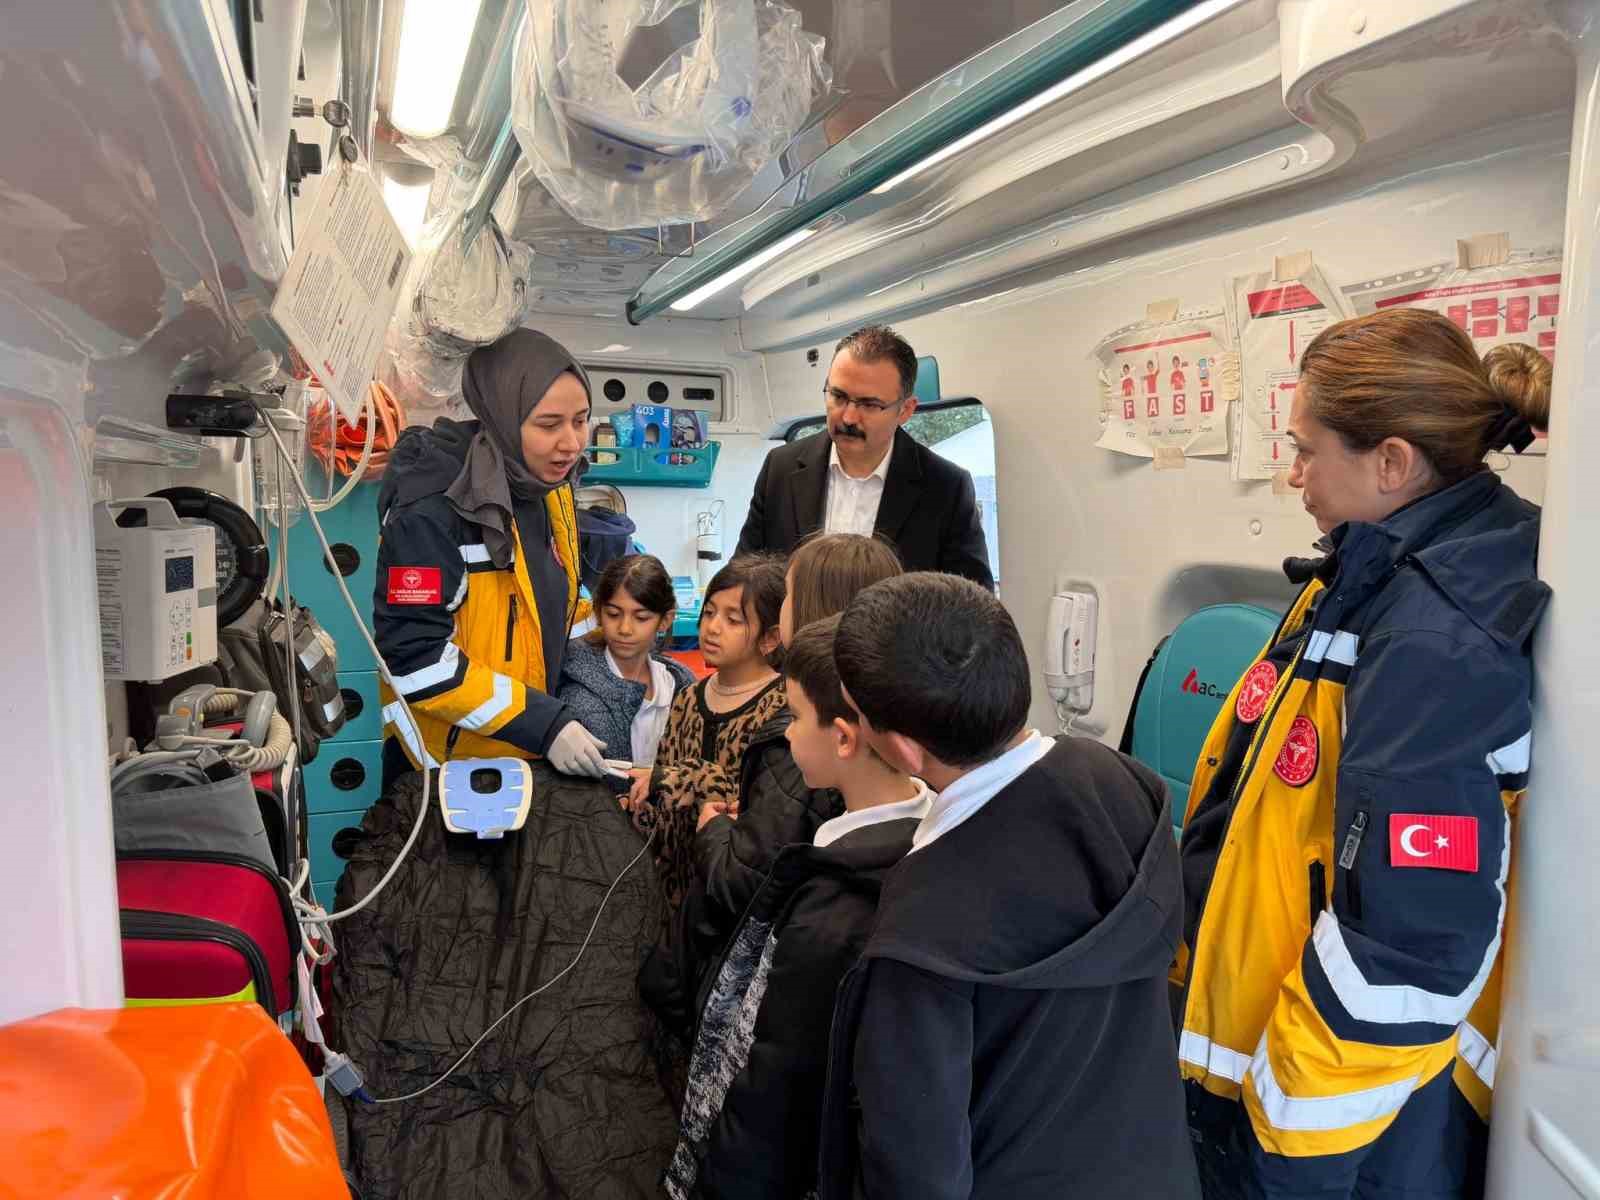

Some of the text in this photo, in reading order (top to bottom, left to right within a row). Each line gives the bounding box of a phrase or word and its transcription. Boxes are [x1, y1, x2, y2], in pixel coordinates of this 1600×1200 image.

[1125, 392, 1212, 417] F A S T
